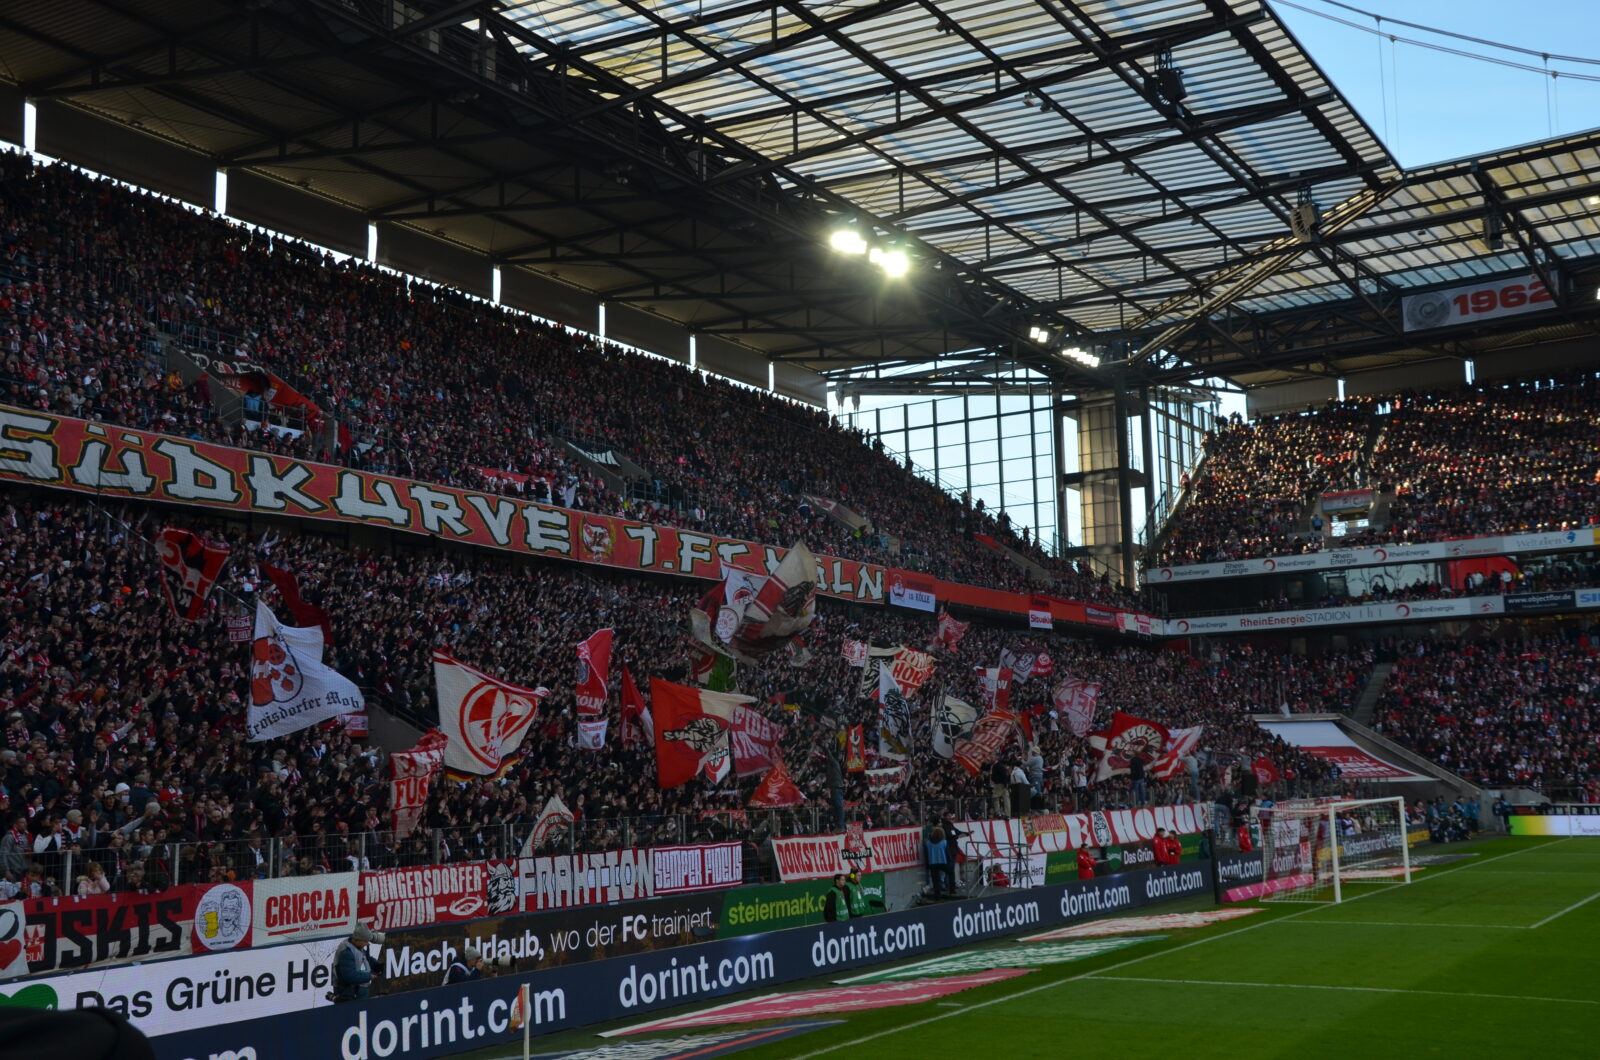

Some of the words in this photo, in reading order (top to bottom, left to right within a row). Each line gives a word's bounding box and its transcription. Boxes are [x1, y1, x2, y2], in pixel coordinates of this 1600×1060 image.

[1453, 281, 1555, 316] 1962
[0, 408, 571, 555] SÜDKURVE
[654, 848, 703, 889] SEMPER
[775, 841, 844, 875] DOMSTADT
[871, 831, 921, 866] SYNDIKAT
[1123, 851, 1137, 865] Das
[518, 847, 654, 912] FRAKTION
[1060, 884, 1131, 917] dorint.com
[1146, 868, 1204, 899] dorint.com
[265, 887, 350, 929] CRICCAA
[300, 923, 319, 933] KÖLN
[374, 897, 436, 931] STADION
[953, 900, 1040, 939] dorint.com
[385, 941, 457, 980] Mach
[550, 930, 580, 953] wo
[586, 920, 617, 948] der
[622, 914, 648, 943] FC
[812, 922, 926, 968] dorint.com
[166, 969, 276, 1012] Grüne
[619, 951, 775, 1009] dorint.com
[341, 987, 566, 1060] dorint.com
